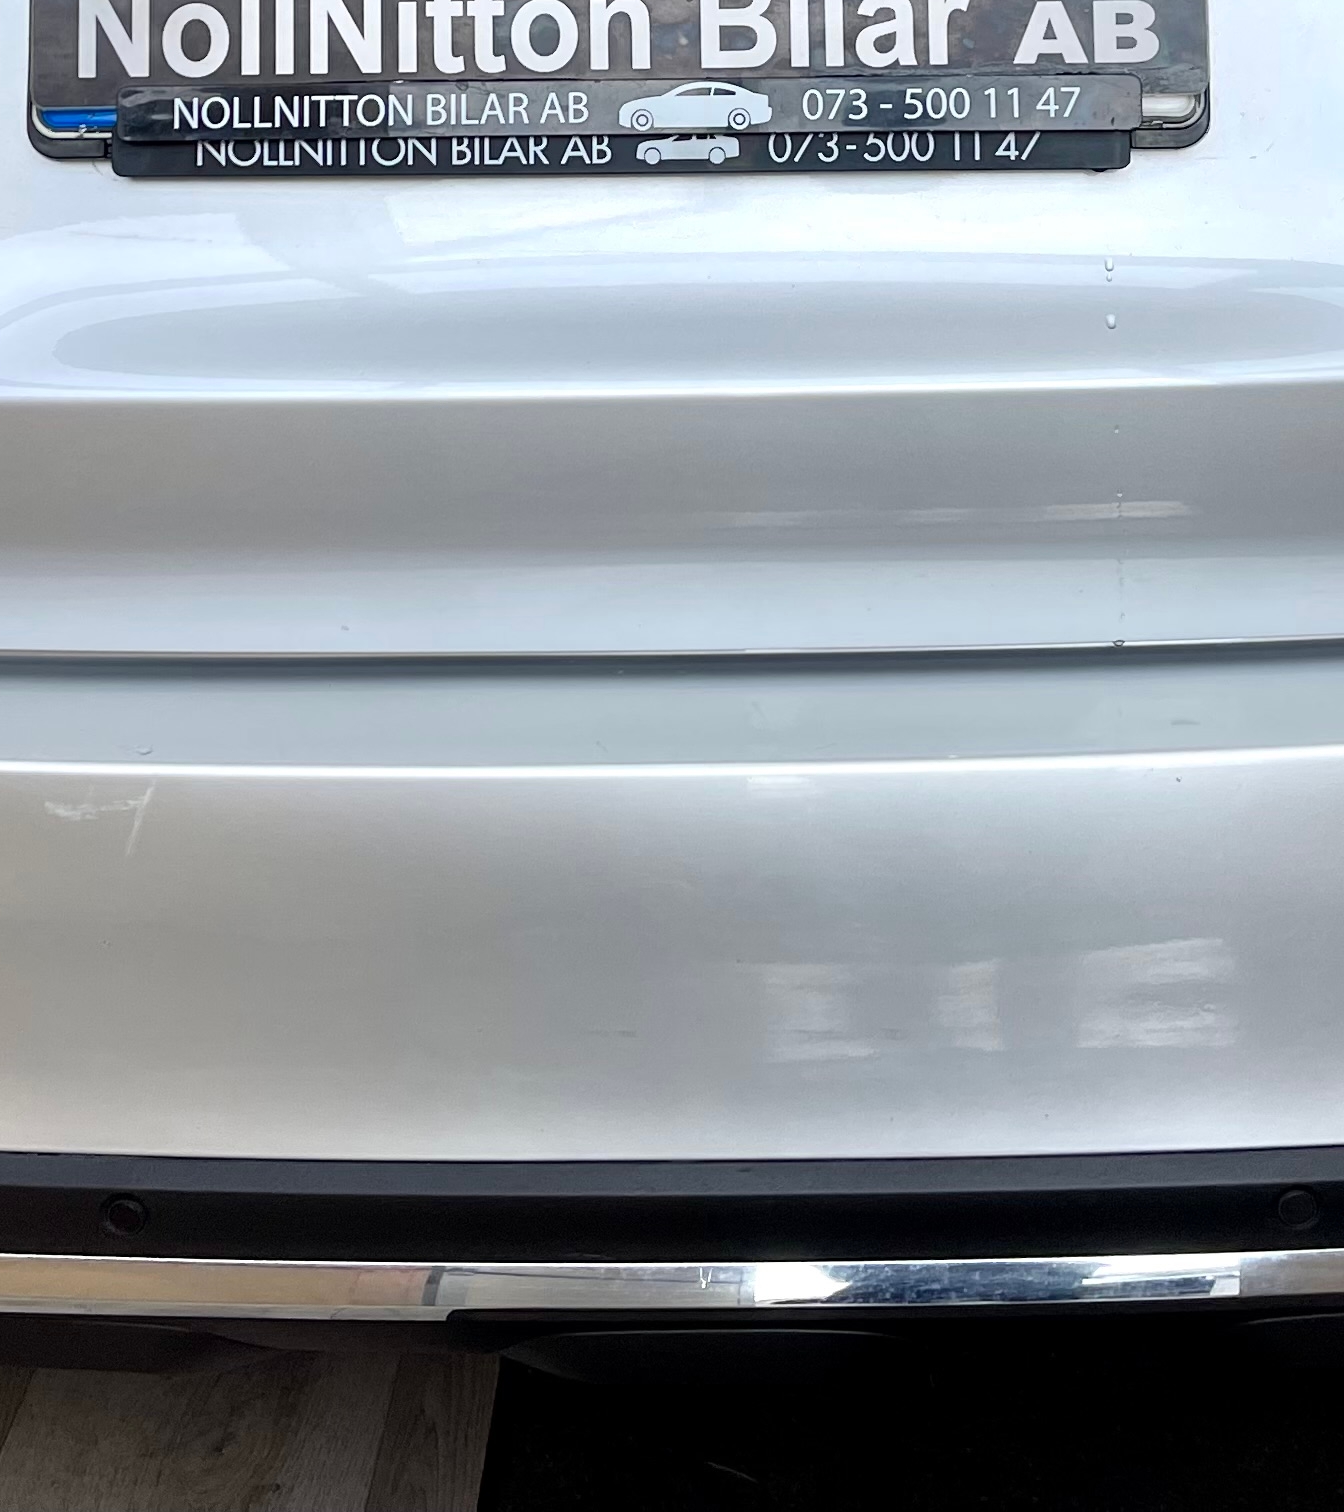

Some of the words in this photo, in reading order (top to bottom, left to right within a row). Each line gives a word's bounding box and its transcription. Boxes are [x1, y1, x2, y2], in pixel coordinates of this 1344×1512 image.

[1012, 0, 1160, 66] AB
[173, 94, 413, 129] NOLLNITTON
[426, 93, 530, 126] BILAR
[539, 92, 589, 125] AB
[802, 88, 868, 120] 073
[903, 87, 971, 120] 500
[984, 87, 1020, 119] 11
[1036, 86, 1081, 119] 47
[451, 137, 549, 166] BILAR
[560, 136, 612, 165] AB
